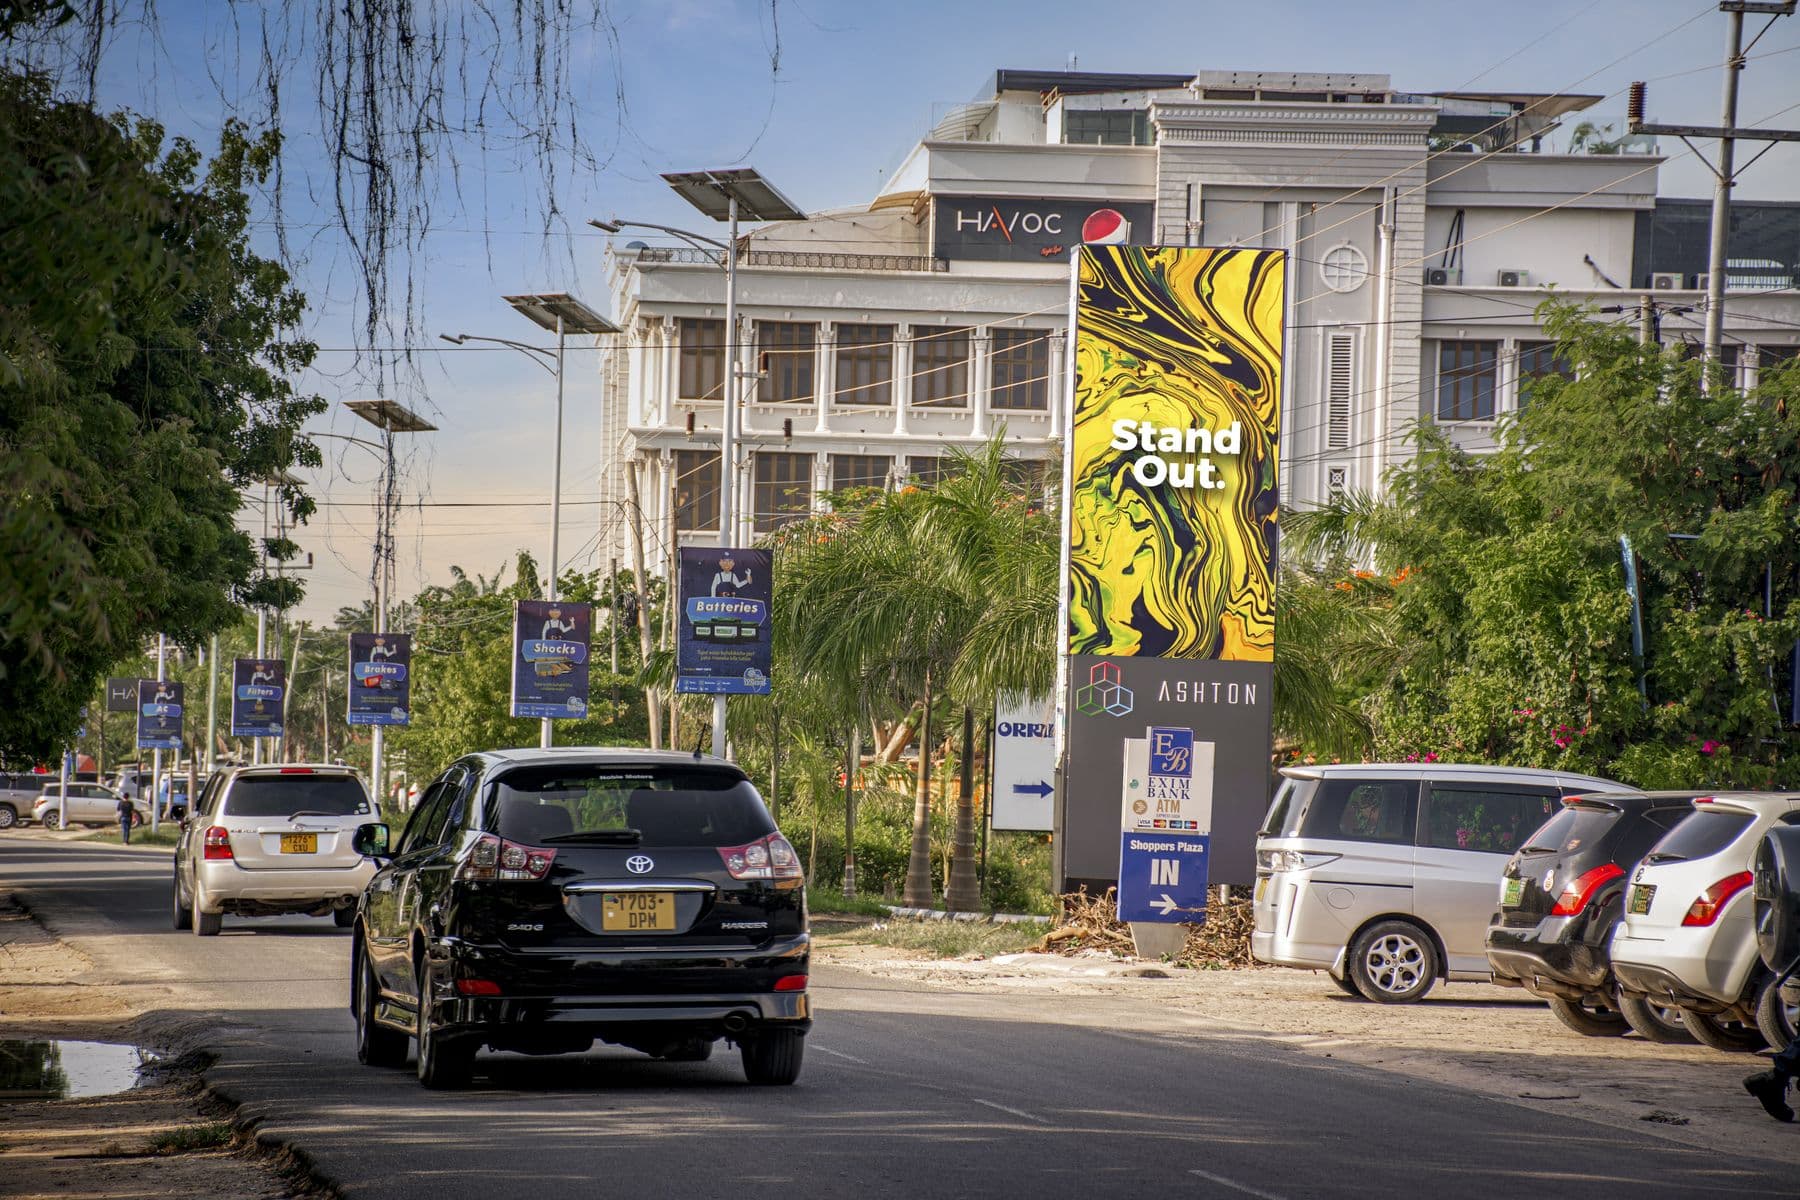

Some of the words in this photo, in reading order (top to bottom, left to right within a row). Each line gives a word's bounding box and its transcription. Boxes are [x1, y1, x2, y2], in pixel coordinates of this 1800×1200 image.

[957, 206, 1062, 243] HAVOC
[1110, 418, 1241, 455] Stand
[1133, 455, 1226, 489] Out.
[696, 601, 758, 614] Batteries
[534, 643, 576, 655] Shocks
[364, 665, 397, 674] Brakes
[112, 687, 138, 700] HA
[247, 687, 273, 696] Filters
[1158, 680, 1257, 705] ASHTON
[156, 705, 169, 713] AC
[1148, 777, 1191, 789] EXIM
[1147, 787, 1191, 800] BANK
[1156, 799, 1181, 813] ATM
[1130, 839, 1175, 852] Shoppers
[1177, 841, 1204, 853] Plaza
[1150, 858, 1180, 886] IN
[618, 894, 656, 911] T703
[629, 912, 657, 929] DPM
